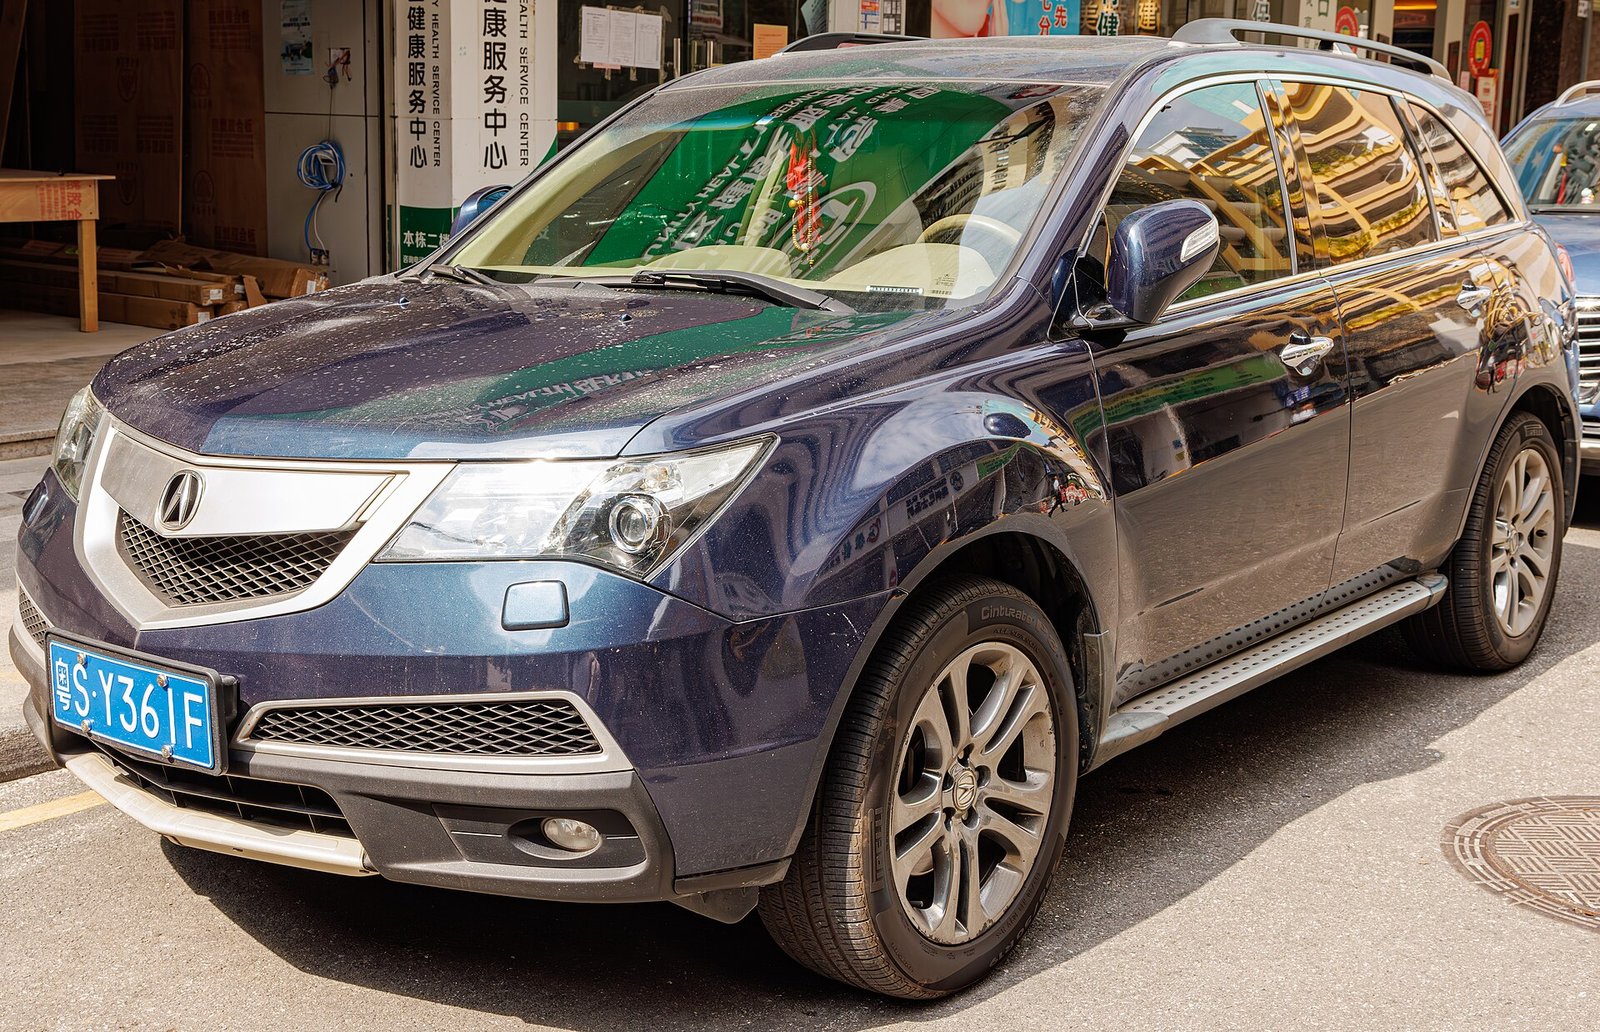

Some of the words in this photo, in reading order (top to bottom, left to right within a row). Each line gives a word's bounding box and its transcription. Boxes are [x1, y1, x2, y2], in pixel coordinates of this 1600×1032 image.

[432, 14, 440, 59] HEALTH
[407, 0, 428, 169] 健康服务中心
[432, 65, 440, 115] SERVICE
[483, 0, 508, 169] 康服务中心
[519, 47, 529, 105] SERVICE
[433, 121, 441, 167] CENTER
[520, 113, 529, 167] CENTER
